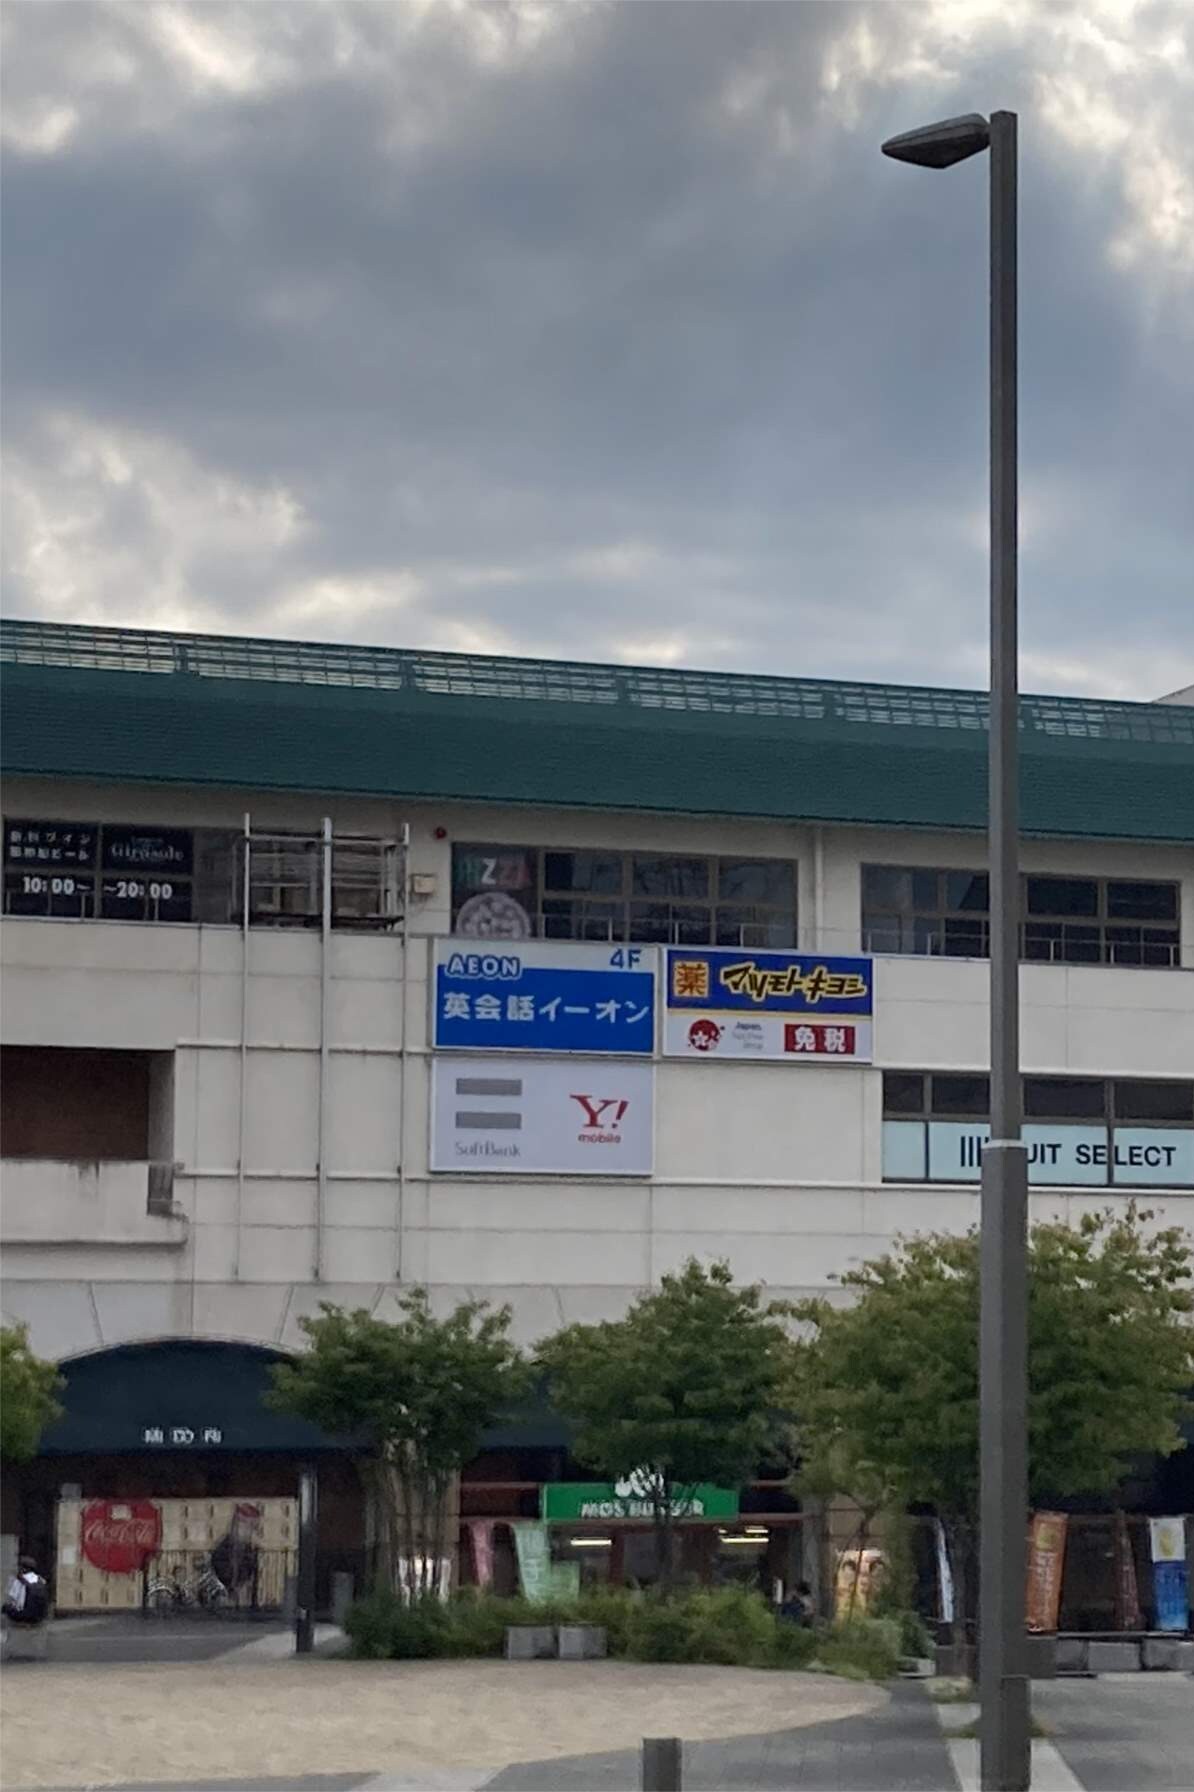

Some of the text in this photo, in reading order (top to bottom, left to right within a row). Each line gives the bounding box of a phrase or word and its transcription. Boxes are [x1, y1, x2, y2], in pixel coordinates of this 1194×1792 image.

[445, 949, 641, 980] AEON 4F
[676, 962, 867, 1002] 薬 マツモトキヨシ
[443, 991, 650, 1024] 英会話イーオン
[794, 1026, 847, 1053] 免税
[455, 1140, 521, 1158] SoftBank
[577, 1132, 622, 1144] mobile
[1075, 1143, 1177, 1167] SELECT
[581, 1501, 625, 1518] MOS
